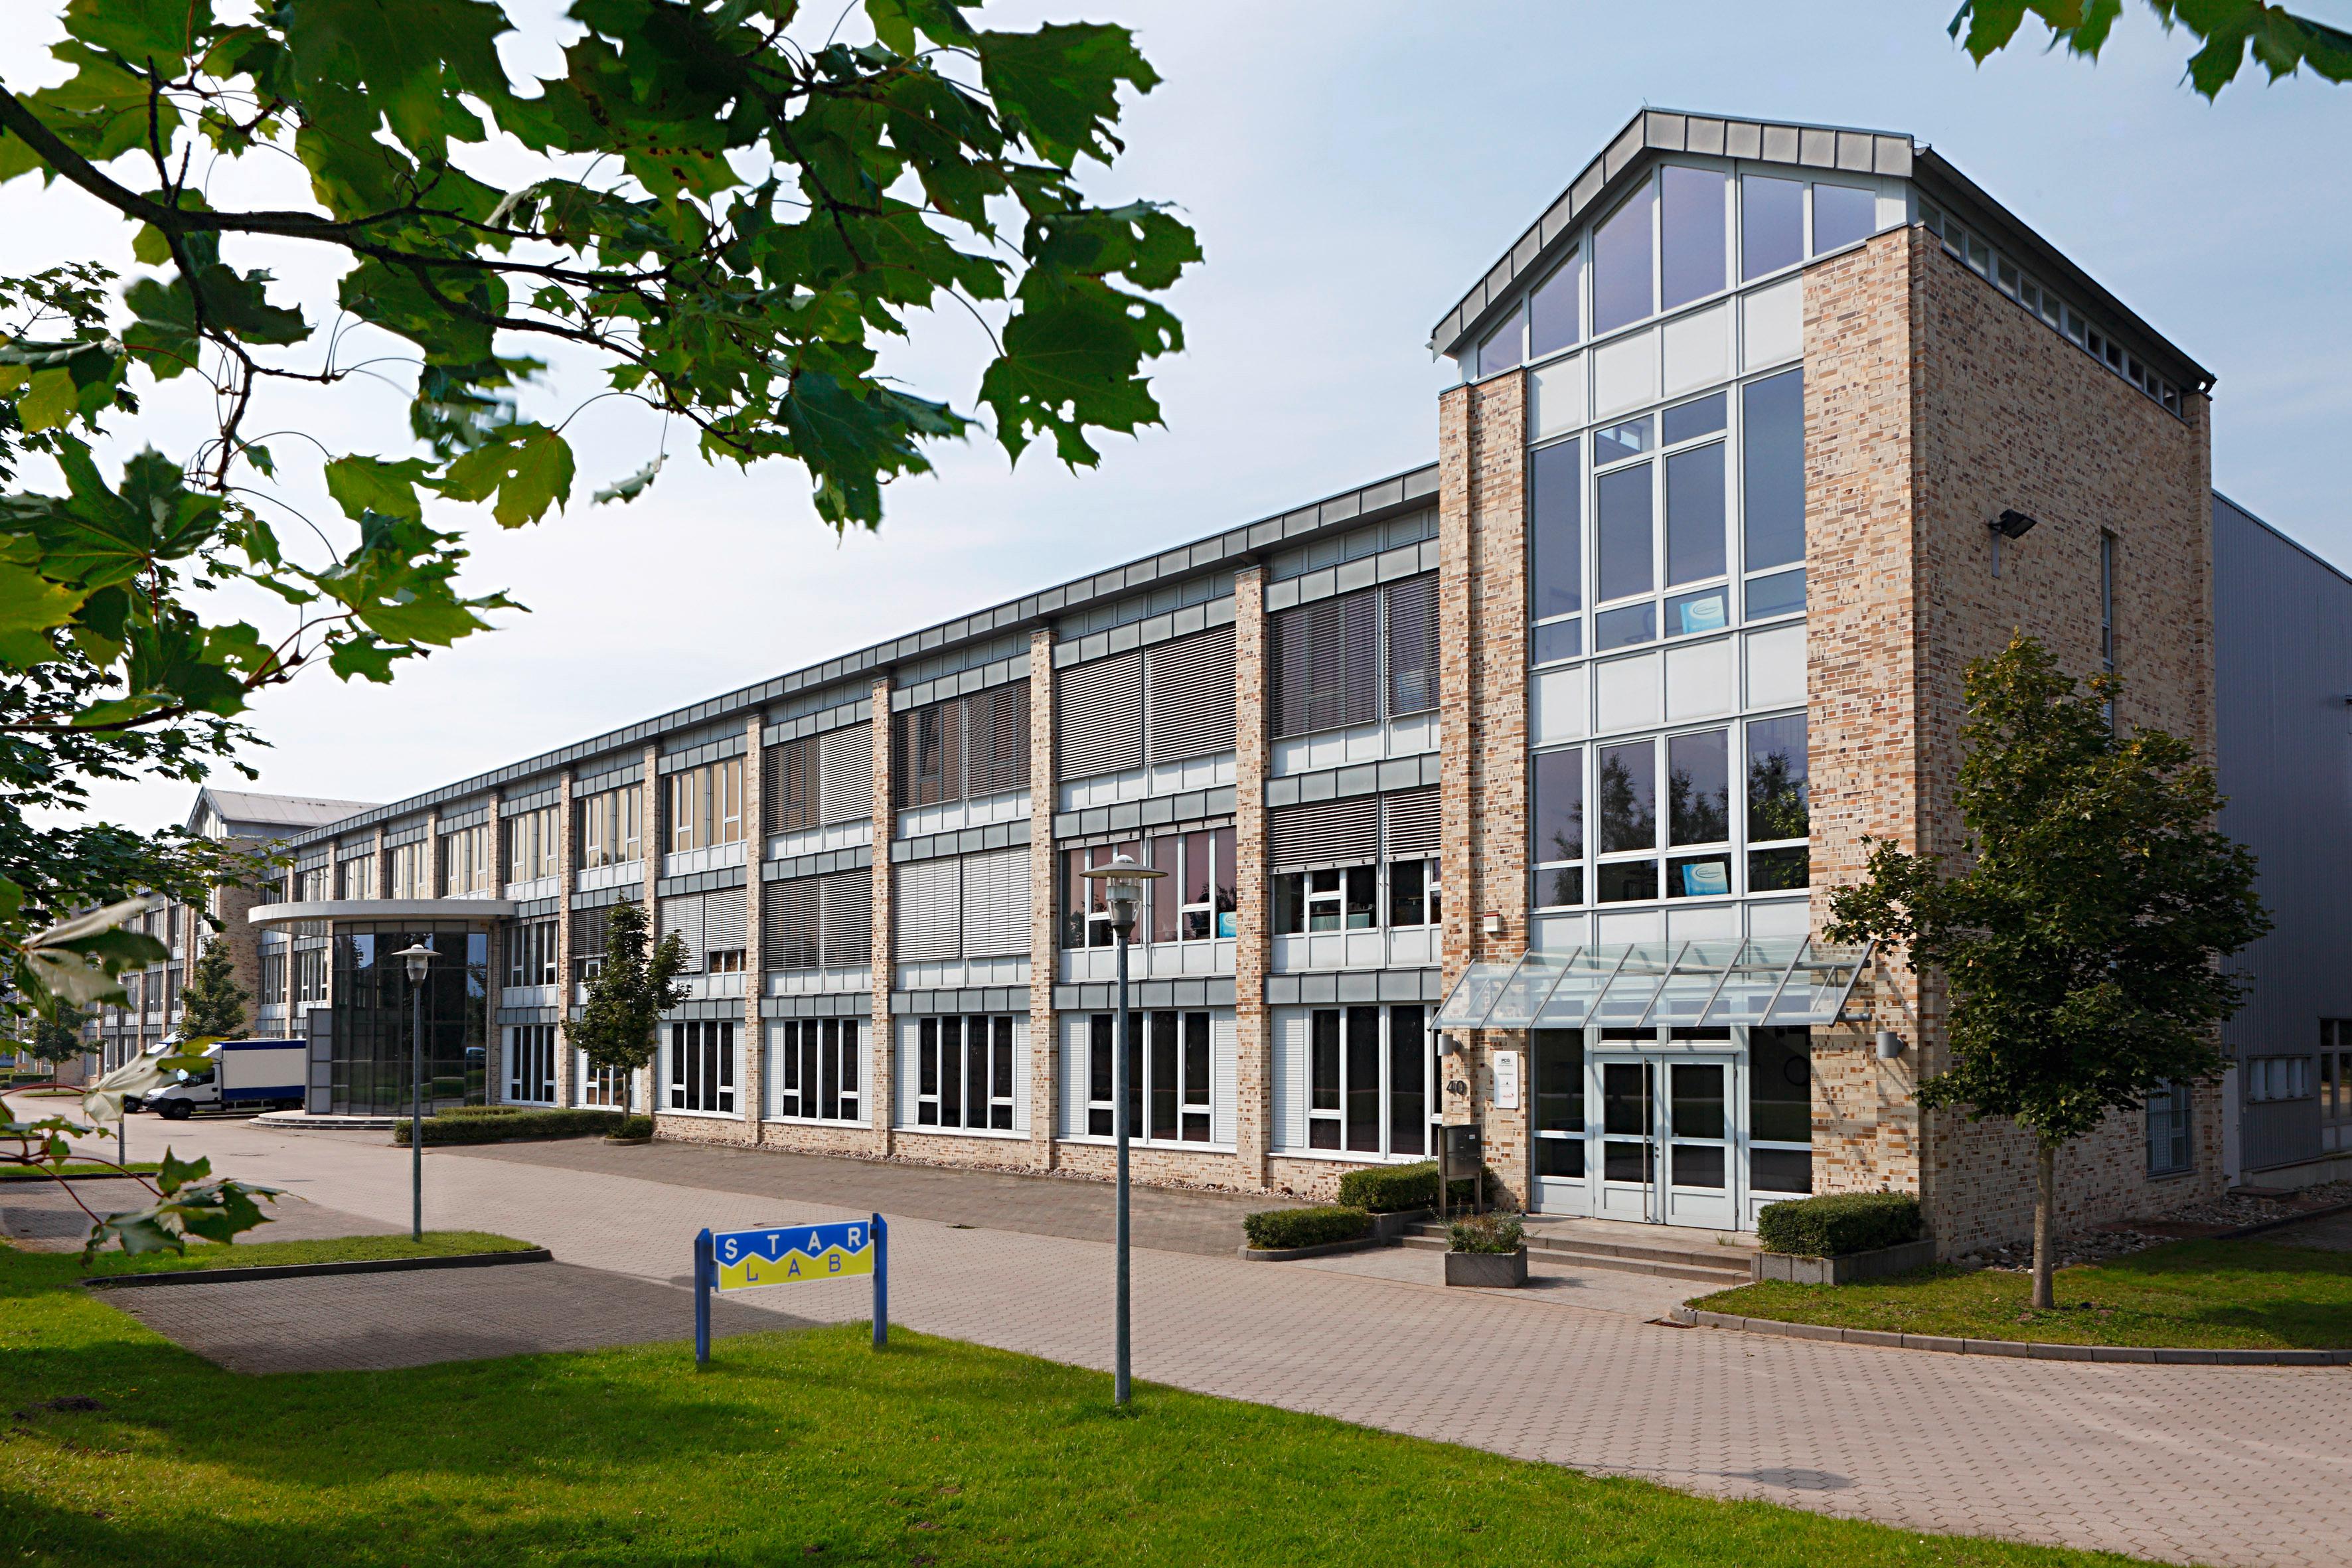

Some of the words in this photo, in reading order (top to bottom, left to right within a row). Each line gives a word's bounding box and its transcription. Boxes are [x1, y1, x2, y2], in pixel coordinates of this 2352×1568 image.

[1447, 1080, 1466, 1095] 40
[724, 1227, 861, 1259] STAR
[746, 1253, 841, 1282] LAB
